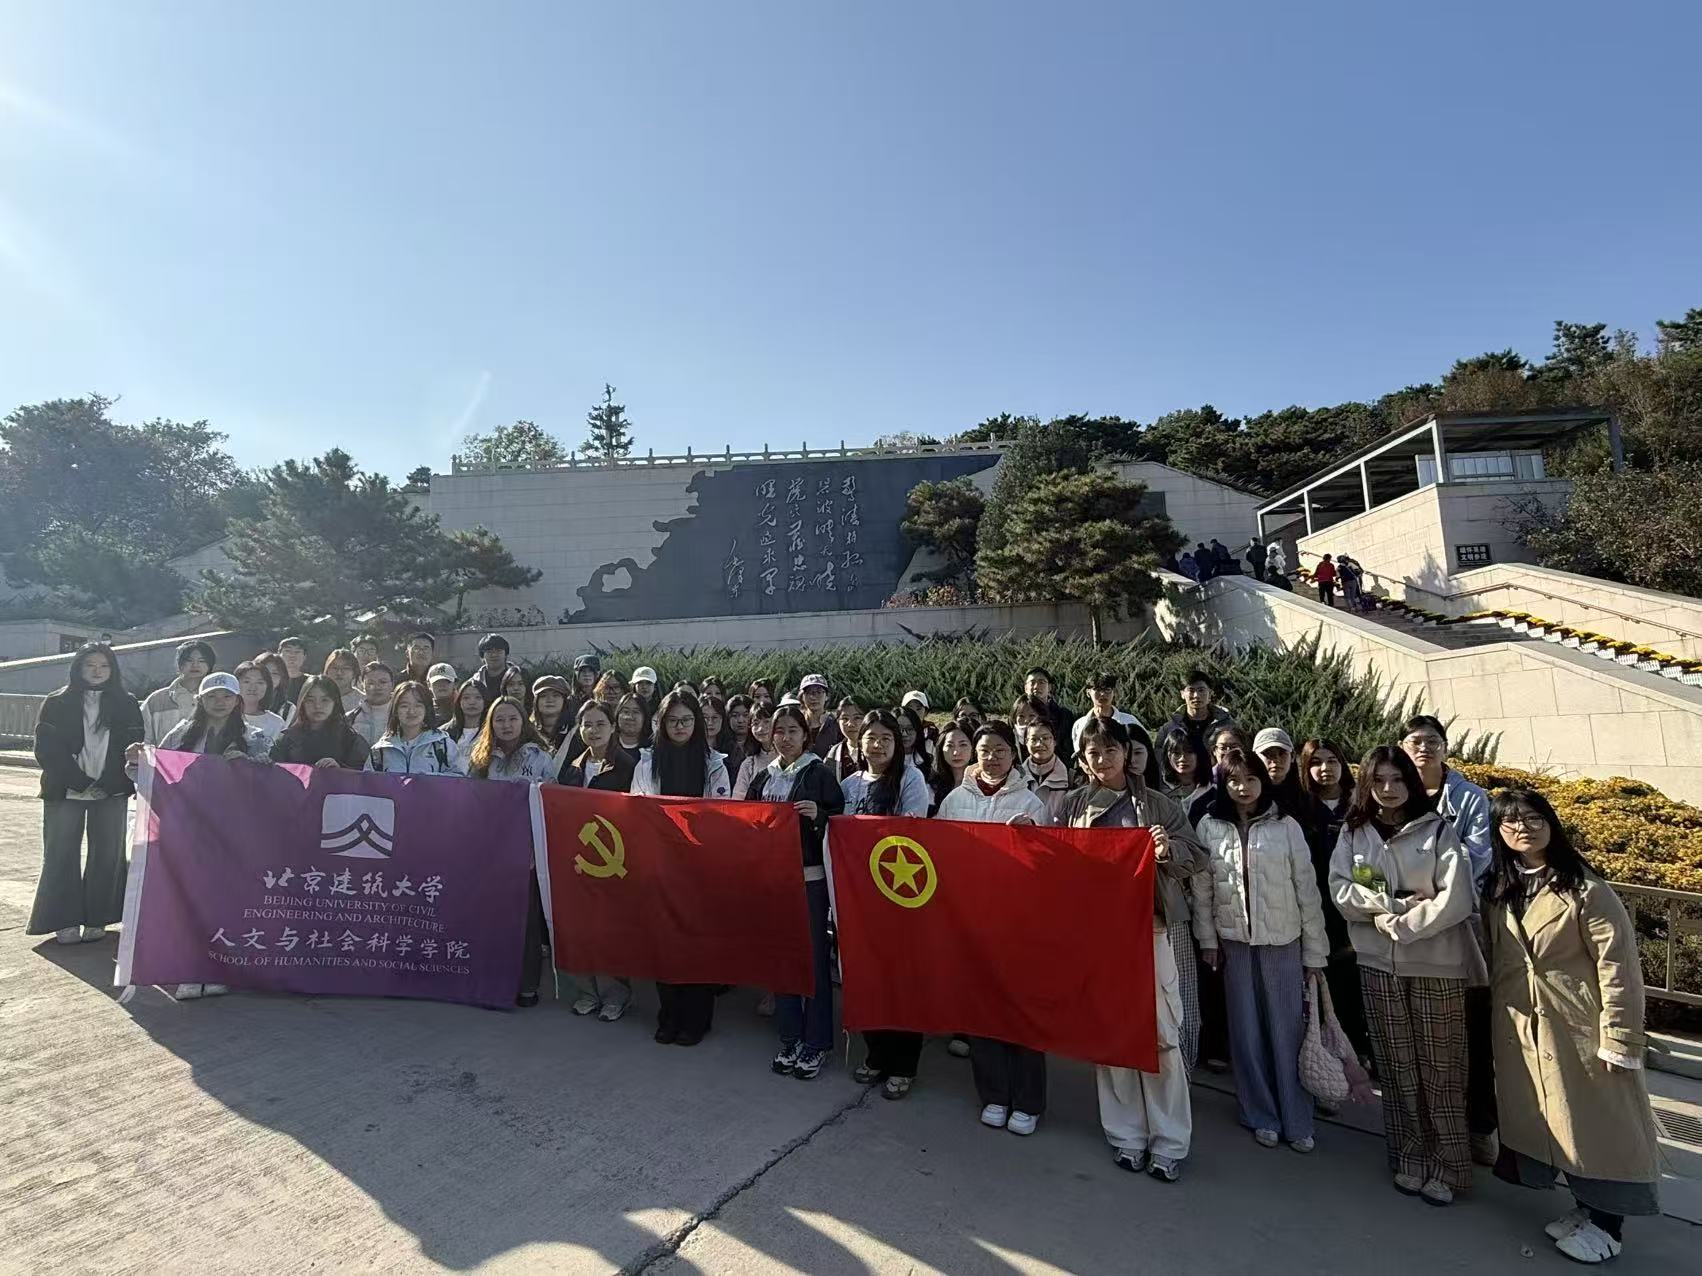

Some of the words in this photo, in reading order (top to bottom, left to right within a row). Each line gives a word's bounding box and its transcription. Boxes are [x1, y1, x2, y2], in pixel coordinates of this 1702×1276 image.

[263, 865, 443, 903] 北京建筑大学
[264, 895, 312, 907] BEIJING
[316, 898, 389, 912] UNIVERSITY
[391, 903, 408, 912] OF
[408, 904, 436, 917] CIVIL
[243, 908, 333, 921] ENGINEERING
[335, 913, 362, 922] AND
[363, 913, 445, 933] ARCHITECTURE
[210, 926, 470, 960] 人文与社会科学学院
[208, 950, 250, 966] SCHOOL
[254, 956, 272, 966] OF
[274, 956, 350, 967] HUMANITIES
[352, 958, 377, 968] AND
[378, 959, 419, 971] SOCIAL
[419, 963, 470, 975] SCIENCES
